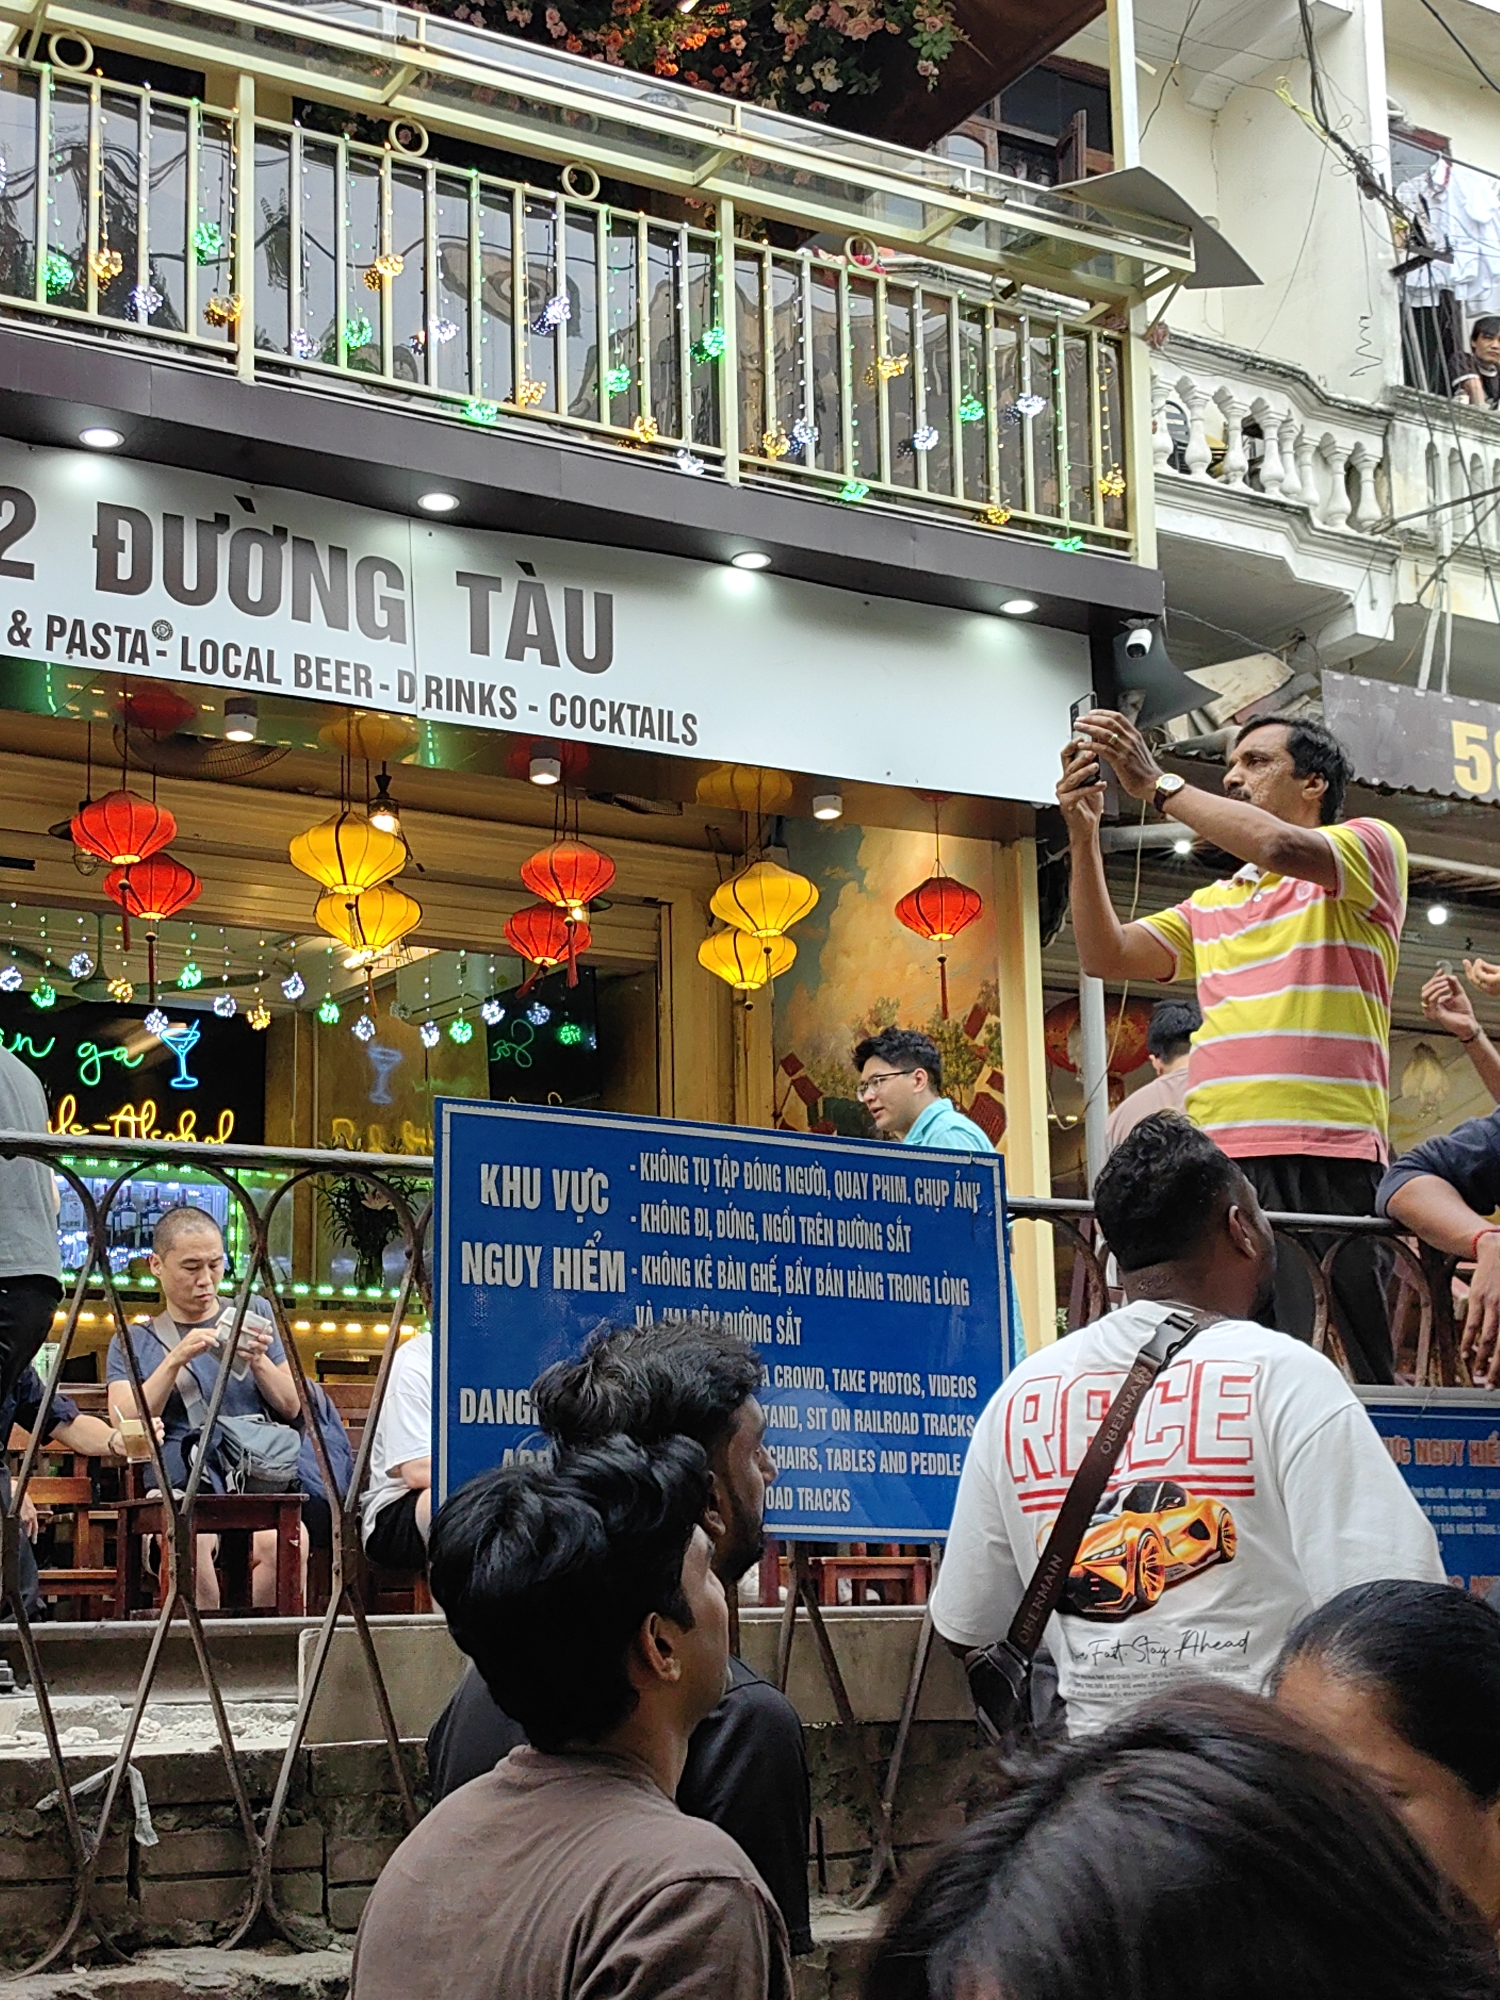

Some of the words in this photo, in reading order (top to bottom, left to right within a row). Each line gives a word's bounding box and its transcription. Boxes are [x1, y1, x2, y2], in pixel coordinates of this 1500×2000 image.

[92, 494, 408, 644] ĐƯỜNG
[455, 560, 613, 674] TÀU
[7, 609, 32, 649] &
[180, 636, 282, 686] LOCAL
[549, 692, 698, 746] COCKTAILS
[480, 1163, 541, 1210] KHU
[552, 1166, 609, 1223] VỰC
[640, 1148, 689, 1185] KHÔNG
[692, 1157, 710, 1192] TỤ
[713, 1153, 740, 1194] TẬP
[785, 1161, 831, 1200] NGƯỜI,
[834, 1170, 869, 1201] QUAY
[914, 1177, 950, 1213] CHỤP
[640, 1199, 690, 1235] KHÔNG
[694, 1207, 712, 1242] ĐI,
[716, 1202, 759, 1245] ĐỨNG,
[762, 1205, 796, 1243] NGỒI
[799, 1213, 834, 1247] TRÊN
[837, 1213, 883, 1251] ĐƯỜNG
[886, 1215, 912, 1253] SẮT
[461, 1241, 542, 1289] NGUY
[553, 1230, 626, 1293] HIỂM
[641, 1250, 691, 1288] KHÔNG
[694, 1253, 713, 1289] KÊ
[717, 1255, 746, 1291] BÀN
[750, 1254, 782, 1297] GHẾ,
[815, 1262, 844, 1298] BÁN
[847, 1264, 884, 1301] HÀNG
[887, 1272, 931, 1304] TRONG
[934, 1271, 970, 1306] LÒNG
[776, 1306, 802, 1346] SẮT
[774, 1365, 830, 1393] CROWD,
[832, 1368, 866, 1393] TAKE
[869, 1371, 926, 1399] PHOTOS,
[928, 1373, 977, 1399] VIDEOS
[806, 1407, 828, 1431] SIT
[831, 1408, 851, 1432] ON
[854, 1409, 919, 1435] RAILROAD
[825, 1448, 876, 1473] TABLES
[880, 1450, 907, 1474] AND
[911, 1452, 961, 1476] PEDDLE
[797, 1487, 851, 1513] TRACKS
[1131, 1635, 1170, 1667] Stay
[1174, 1629, 1251, 1660] Ahead
